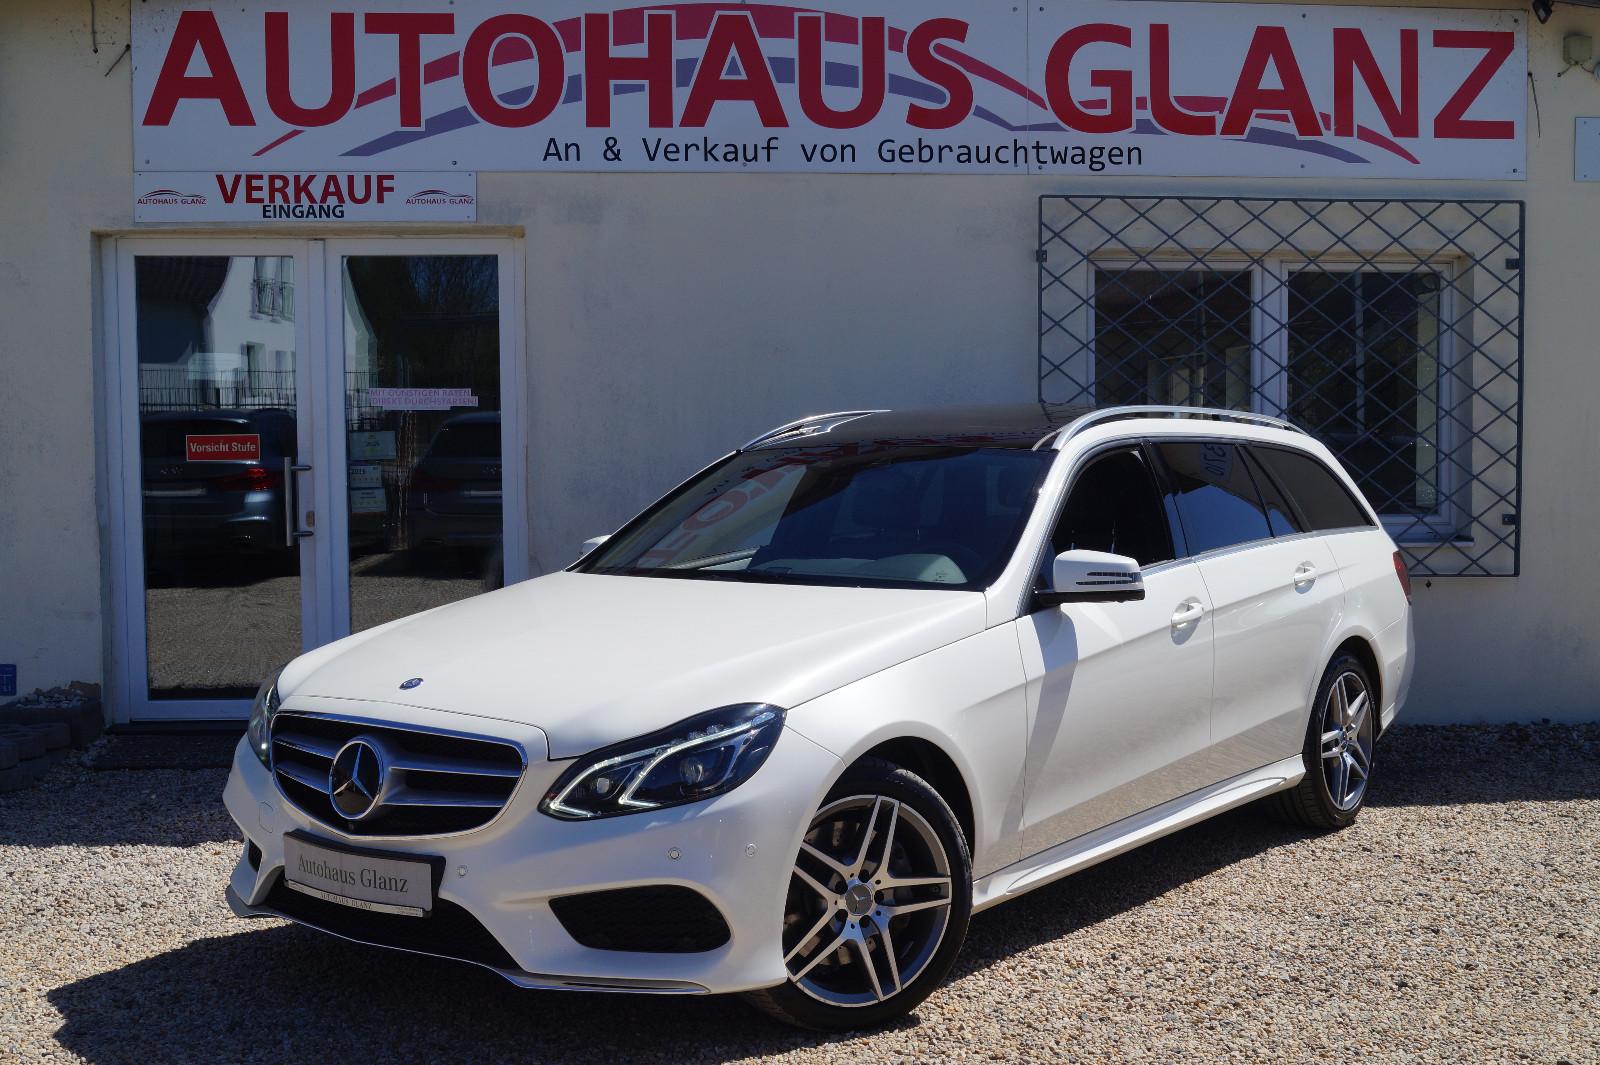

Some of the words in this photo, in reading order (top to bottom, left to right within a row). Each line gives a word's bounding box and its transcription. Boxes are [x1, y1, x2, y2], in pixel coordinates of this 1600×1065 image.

[142, 10, 974, 130] AUTOHAUS
[1045, 23, 1516, 139] GLANZ
[542, 137, 582, 162] An
[602, 137, 622, 162] &
[641, 136, 780, 163] Verkauf
[802, 144, 857, 163] von
[877, 136, 1144, 172] Gebrauchtwagen
[215, 174, 395, 205] VERKAUF
[262, 204, 345, 219] EINGANG
[190, 442, 230, 453] Vorsicht
[231, 442, 256, 452] Stufe
[298, 855, 356, 886] Autohaus
[360, 868, 409, 893] Glanz
